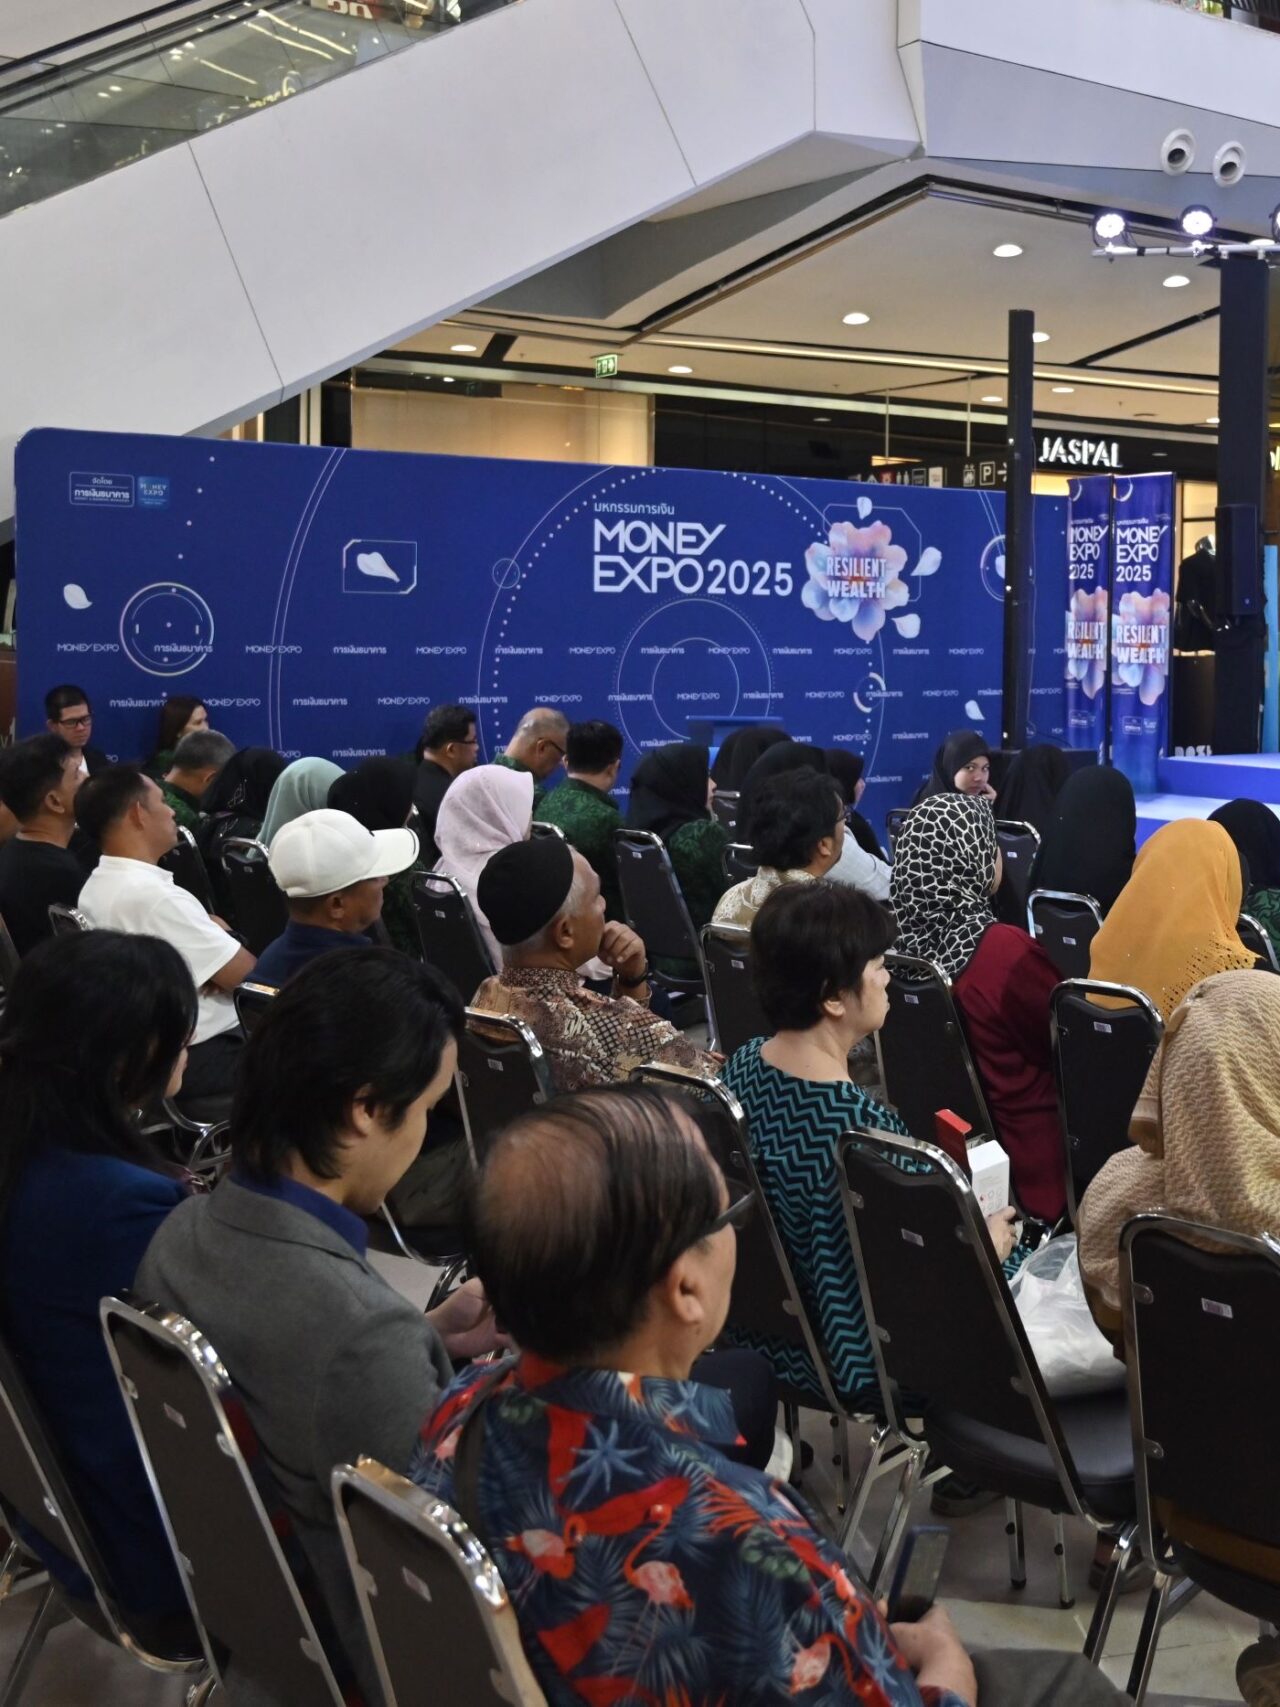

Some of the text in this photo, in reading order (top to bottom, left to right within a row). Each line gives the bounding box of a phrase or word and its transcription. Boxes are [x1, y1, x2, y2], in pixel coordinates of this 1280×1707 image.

[1039, 437, 1121, 468] JASPAL
[983, 466, 991, 481] P
[594, 502, 675, 516] มหกรรมการเงิน
[594, 518, 726, 555] MONEY
[1117, 525, 1168, 545] MONEY
[1069, 543, 1100, 561] EXPO
[1117, 544, 1159, 563] EXPO
[593, 555, 793, 596] EXPO 2025
[826, 556, 887, 578] RESILIENT
[1116, 565, 1151, 582] 2025
[827, 579, 886, 599] WEALTH
[57, 643, 119, 652] MONEY EXPO
[245, 645, 302, 654] MONEY EXPO
[416, 646, 467, 654] MONEY EXPO
[203, 698, 261, 707] MONEY EXPO
[378, 697, 430, 705] MONEY EXPO
